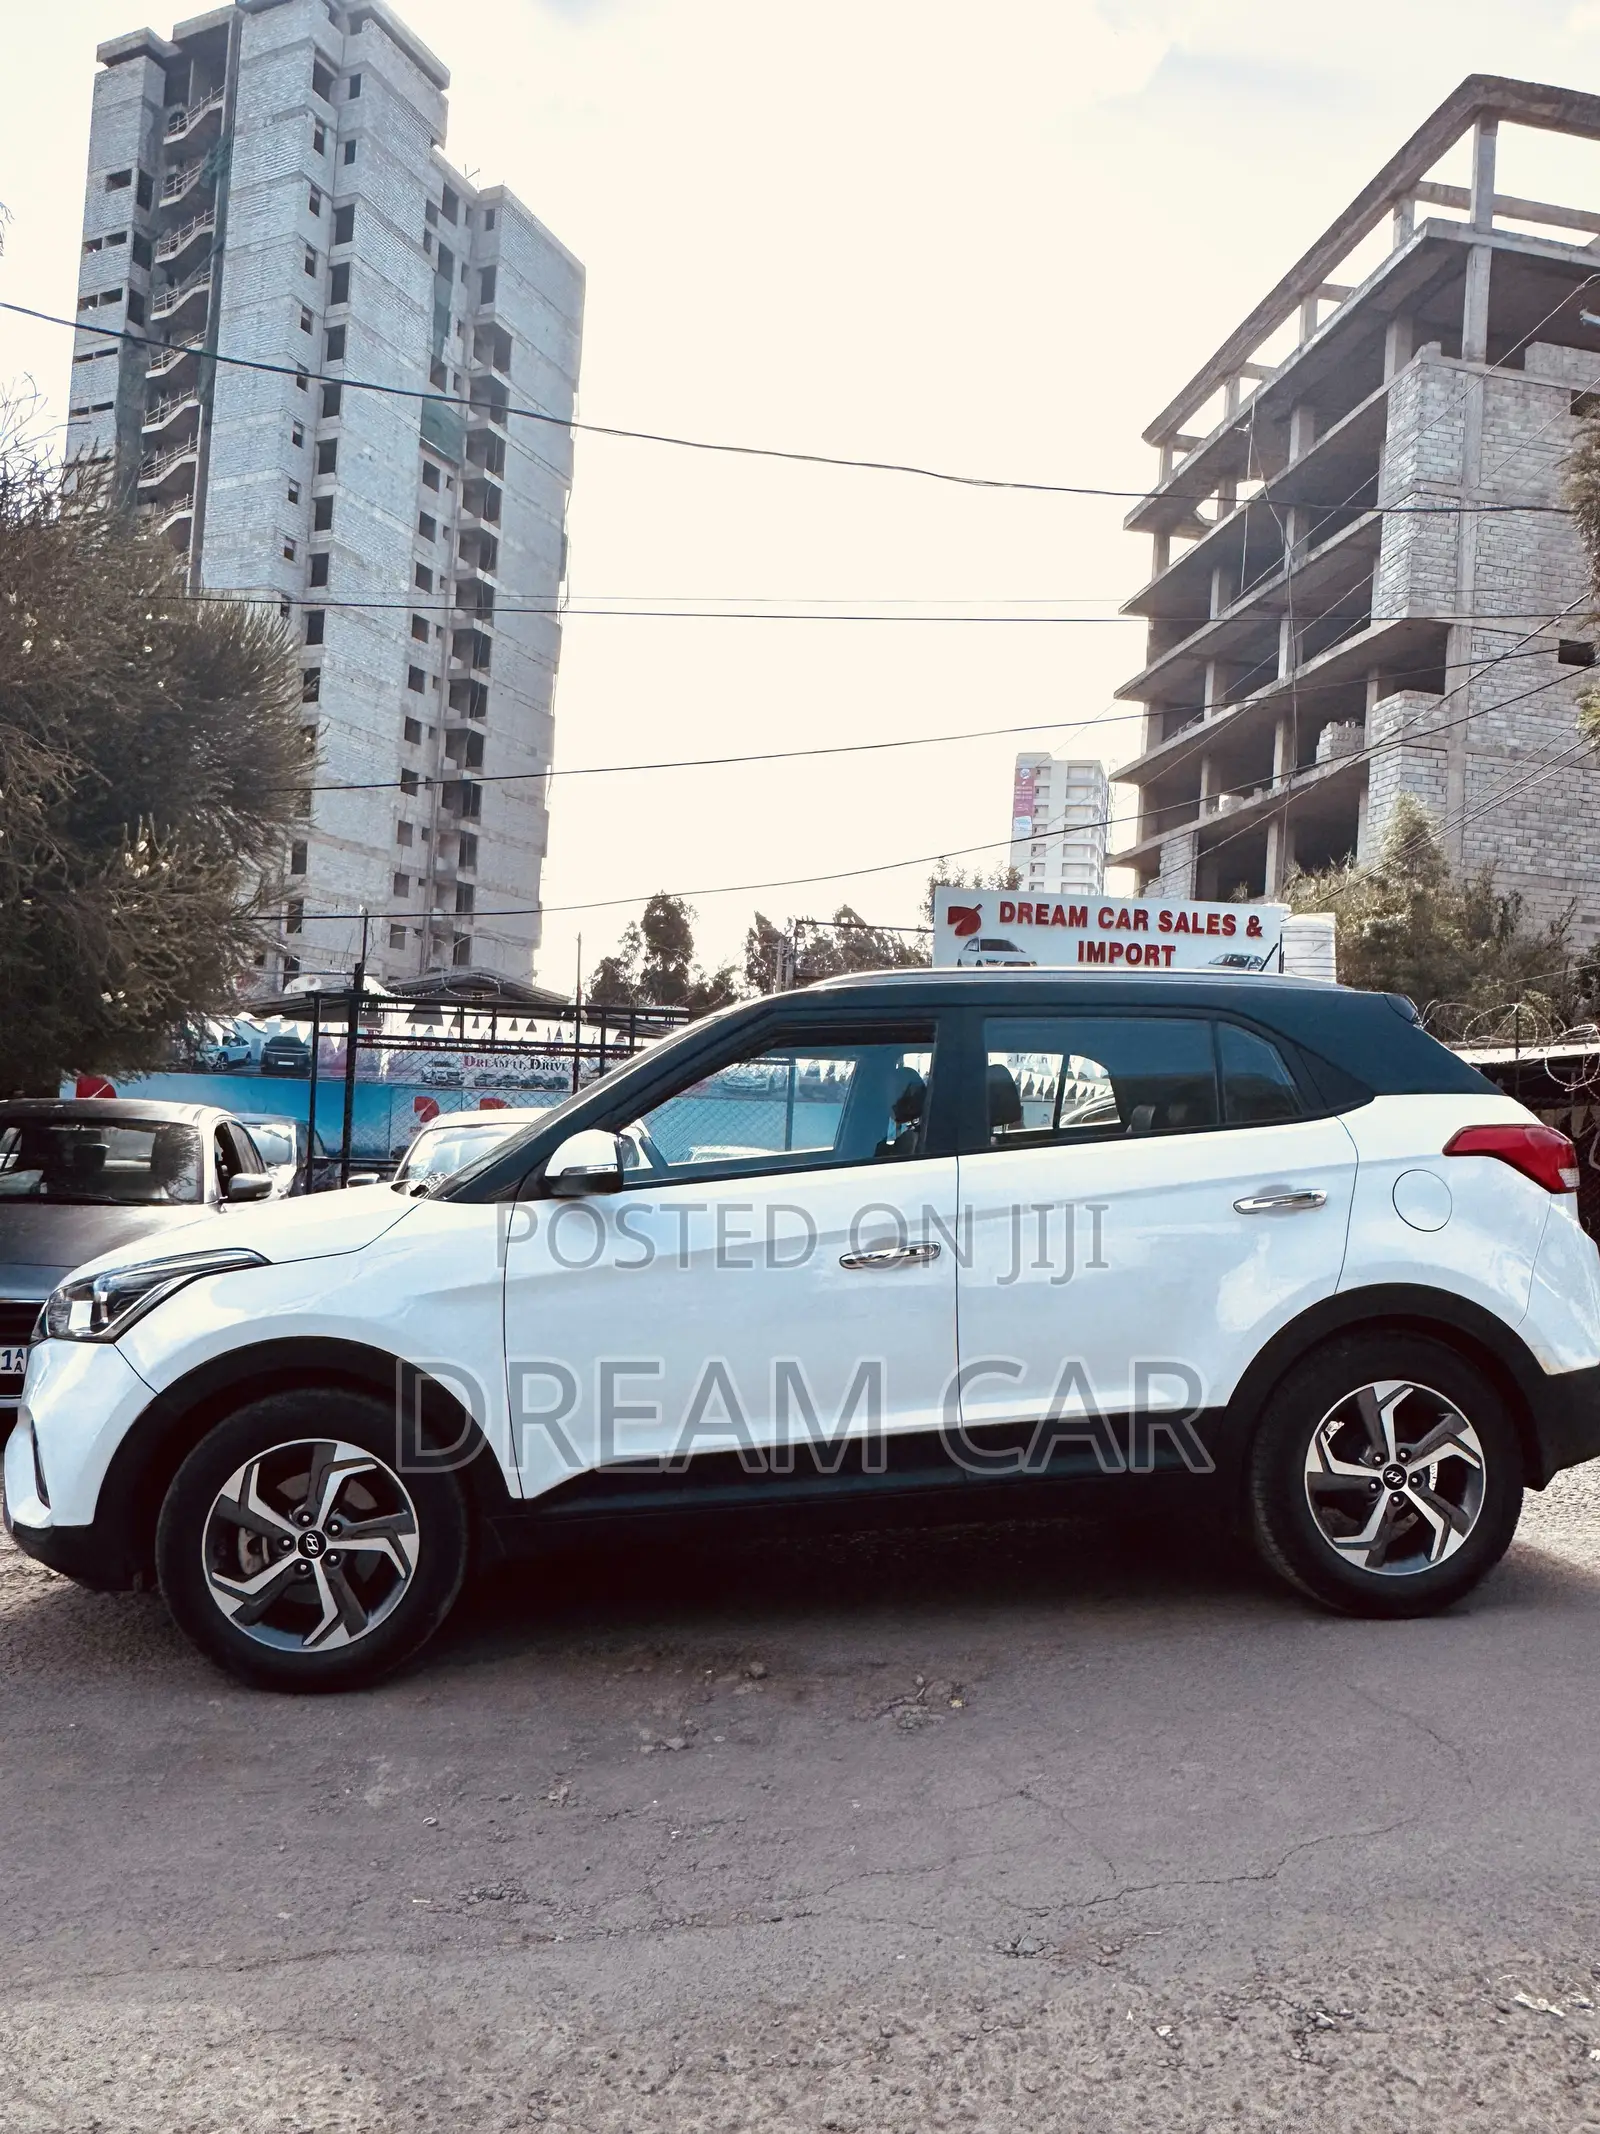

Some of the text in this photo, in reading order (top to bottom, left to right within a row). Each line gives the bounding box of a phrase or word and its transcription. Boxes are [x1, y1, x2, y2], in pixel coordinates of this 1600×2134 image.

[999, 901, 1264, 938] DREAM CAR SALES &
[1078, 940, 1176, 967] IMPORT
